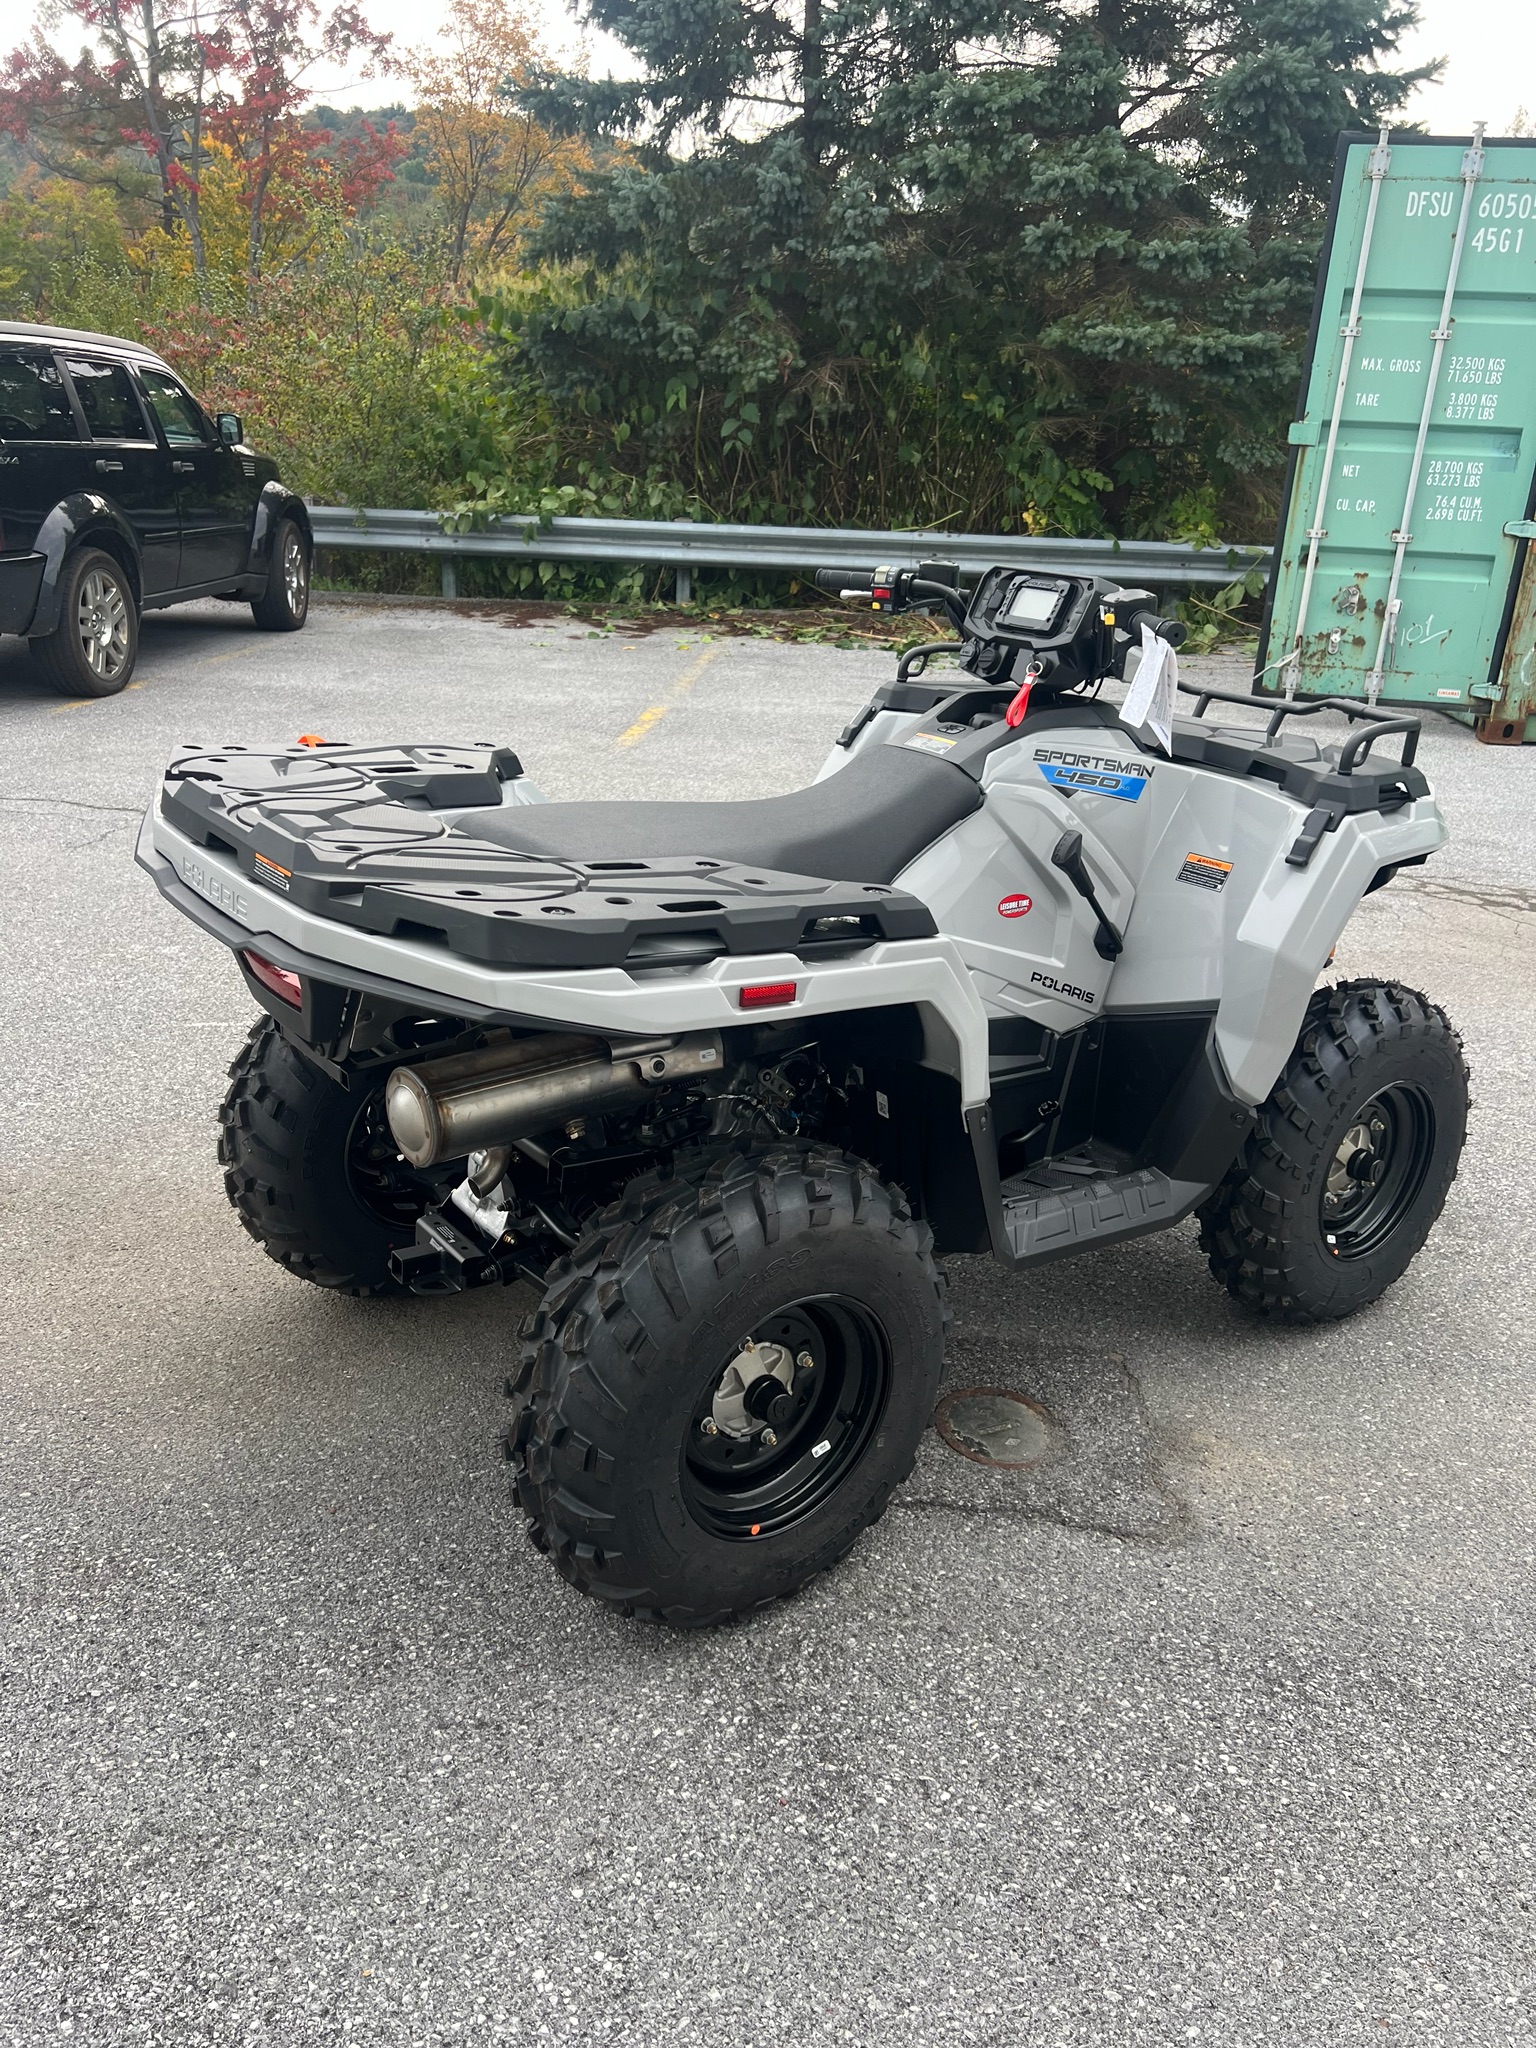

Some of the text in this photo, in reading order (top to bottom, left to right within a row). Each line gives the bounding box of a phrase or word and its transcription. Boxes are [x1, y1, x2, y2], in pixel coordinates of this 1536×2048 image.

[1405, 191, 1454, 217] DFSU
[1471, 228, 1524, 254] 45G1
[1360, 357, 1421, 373] MAX. GROSS
[1449, 356, 1506, 372] 32.500 KGS
[1447, 370, 1502, 385] 71.650 LBS
[1355, 392, 1380, 407] TARE
[1448, 392, 1498, 407] 3.800 KGS
[1446, 406, 1495, 421] 8.377 LBS
[1342, 464, 1361, 478] NET
[1428, 460, 1484, 475] 28.700 KGS
[1426, 473, 1481, 488] 63.273 LBS
[1336, 498, 1376, 513] CU. CAP.
[1435, 495, 1483, 510] 76.4 CU.M.
[1425, 507, 1483, 523] 2.698 CU.FT.
[1032, 749, 1156, 778] SPORTSMAN
[1055, 768, 1122, 791] 450
[183, 856, 249, 921] POLARIS
[1000, 900, 1018, 911] LEISURE
[1030, 971, 1096, 1004] POLARIS
